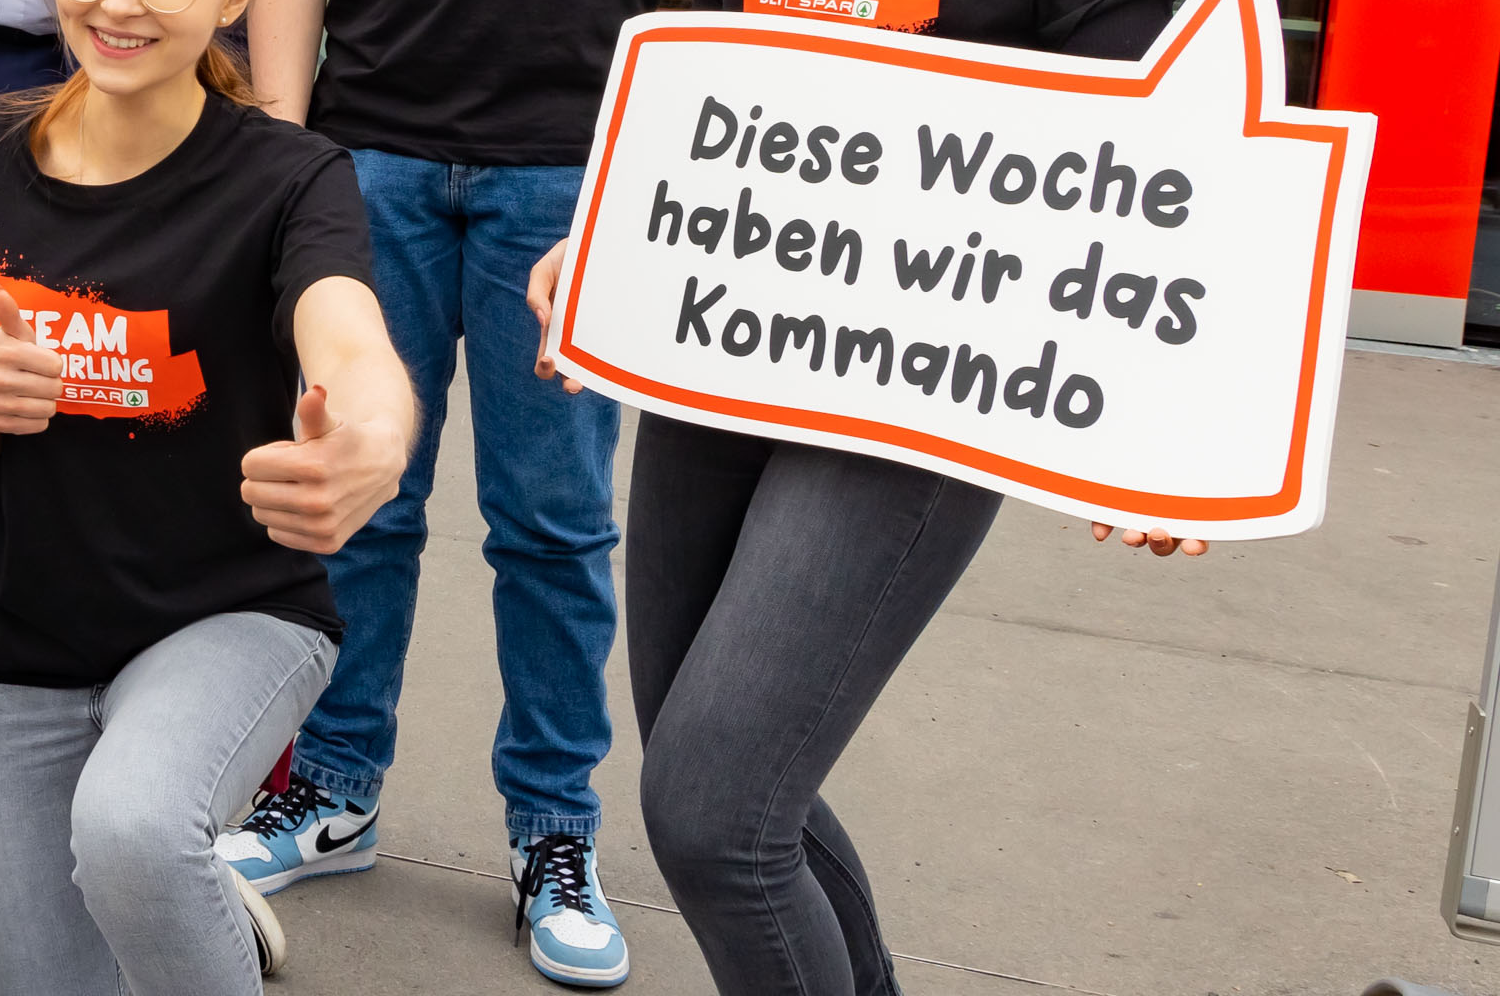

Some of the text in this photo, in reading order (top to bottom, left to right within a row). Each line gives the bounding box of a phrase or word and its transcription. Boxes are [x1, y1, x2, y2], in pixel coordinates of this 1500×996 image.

[691, 96, 1193, 228] Diese Woche
[647, 180, 1206, 345] haben wir das
[65, 387, 122, 403] SPAR
[675, 276, 1104, 429] Kommando
